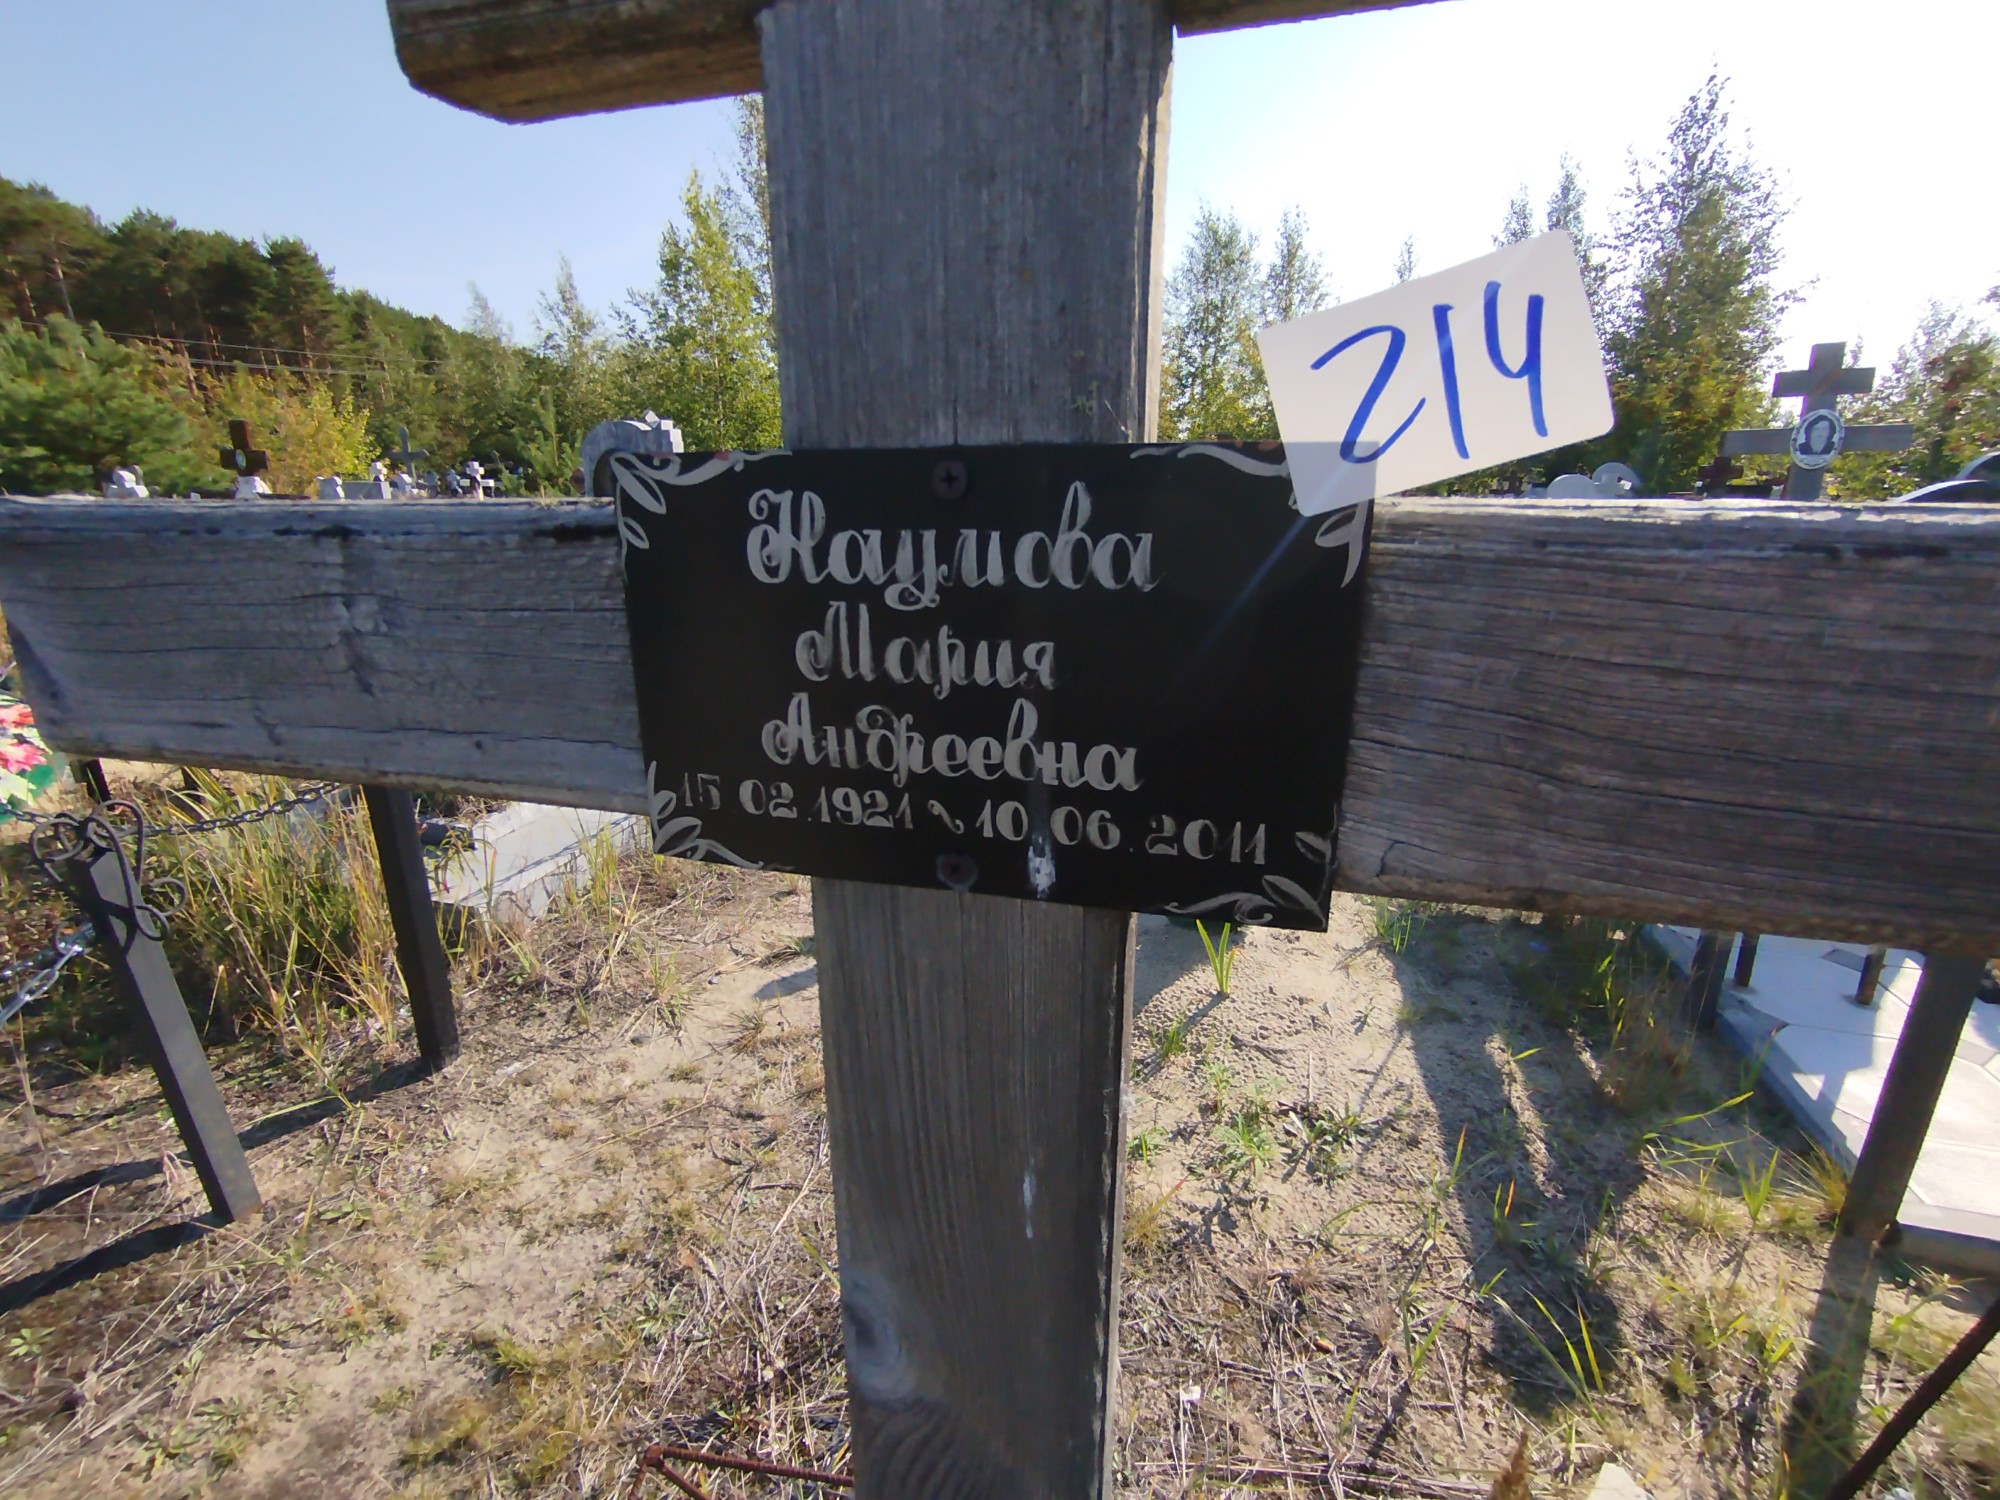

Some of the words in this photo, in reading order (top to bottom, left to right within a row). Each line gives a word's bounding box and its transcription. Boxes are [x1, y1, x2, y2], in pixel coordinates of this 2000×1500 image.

[1310, 280, 1549, 465] 214
[746, 480, 1166, 611] Наумова
[795, 601, 1056, 699] Мария
[761, 692, 1145, 791] Андреевна
